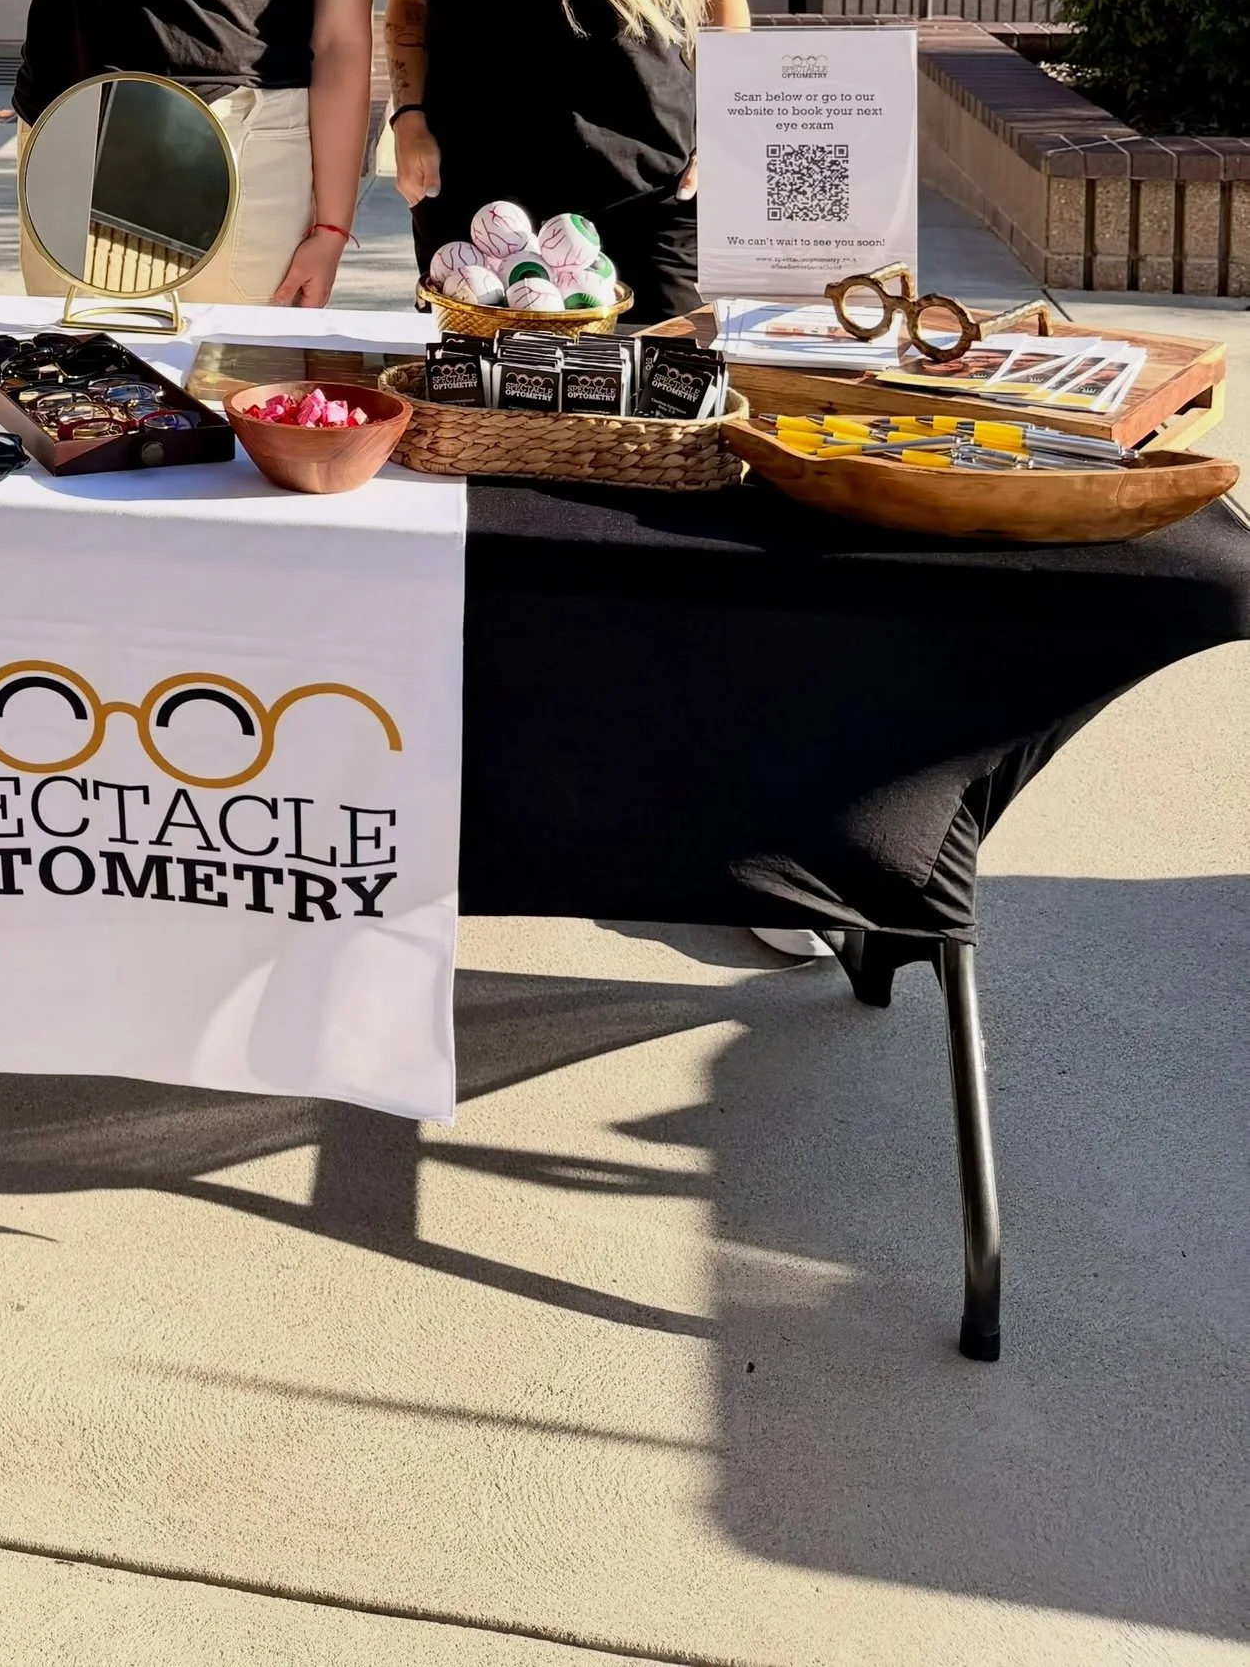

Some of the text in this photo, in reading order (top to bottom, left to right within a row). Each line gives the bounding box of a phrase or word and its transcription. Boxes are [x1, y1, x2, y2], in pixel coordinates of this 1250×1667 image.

[734, 92, 875, 104] Scan below or go to our
[727, 106, 882, 118] website to book your next
[776, 122, 834, 132] eye exam
[727, 237, 745, 246] We
[748, 236, 773, 246] can't
[776, 237, 797, 246] wait
[800, 238, 811, 246] to
[835, 239, 854, 248] you
[857, 238, 885, 247] soon!
[432, 373, 477, 384] SPECTACLE
[654, 374, 700, 395] SPECTACLE
[433, 381, 477, 390] OPTOMETRY
[505, 382, 554, 395] SPECTACLE
[567, 385, 616, 396] SPECTACLE
[505, 389, 553, 401] OPTOMETRY
[567, 392, 616, 401] OPTOMETRY
[652, 382, 699, 402] OPTOMETRY
